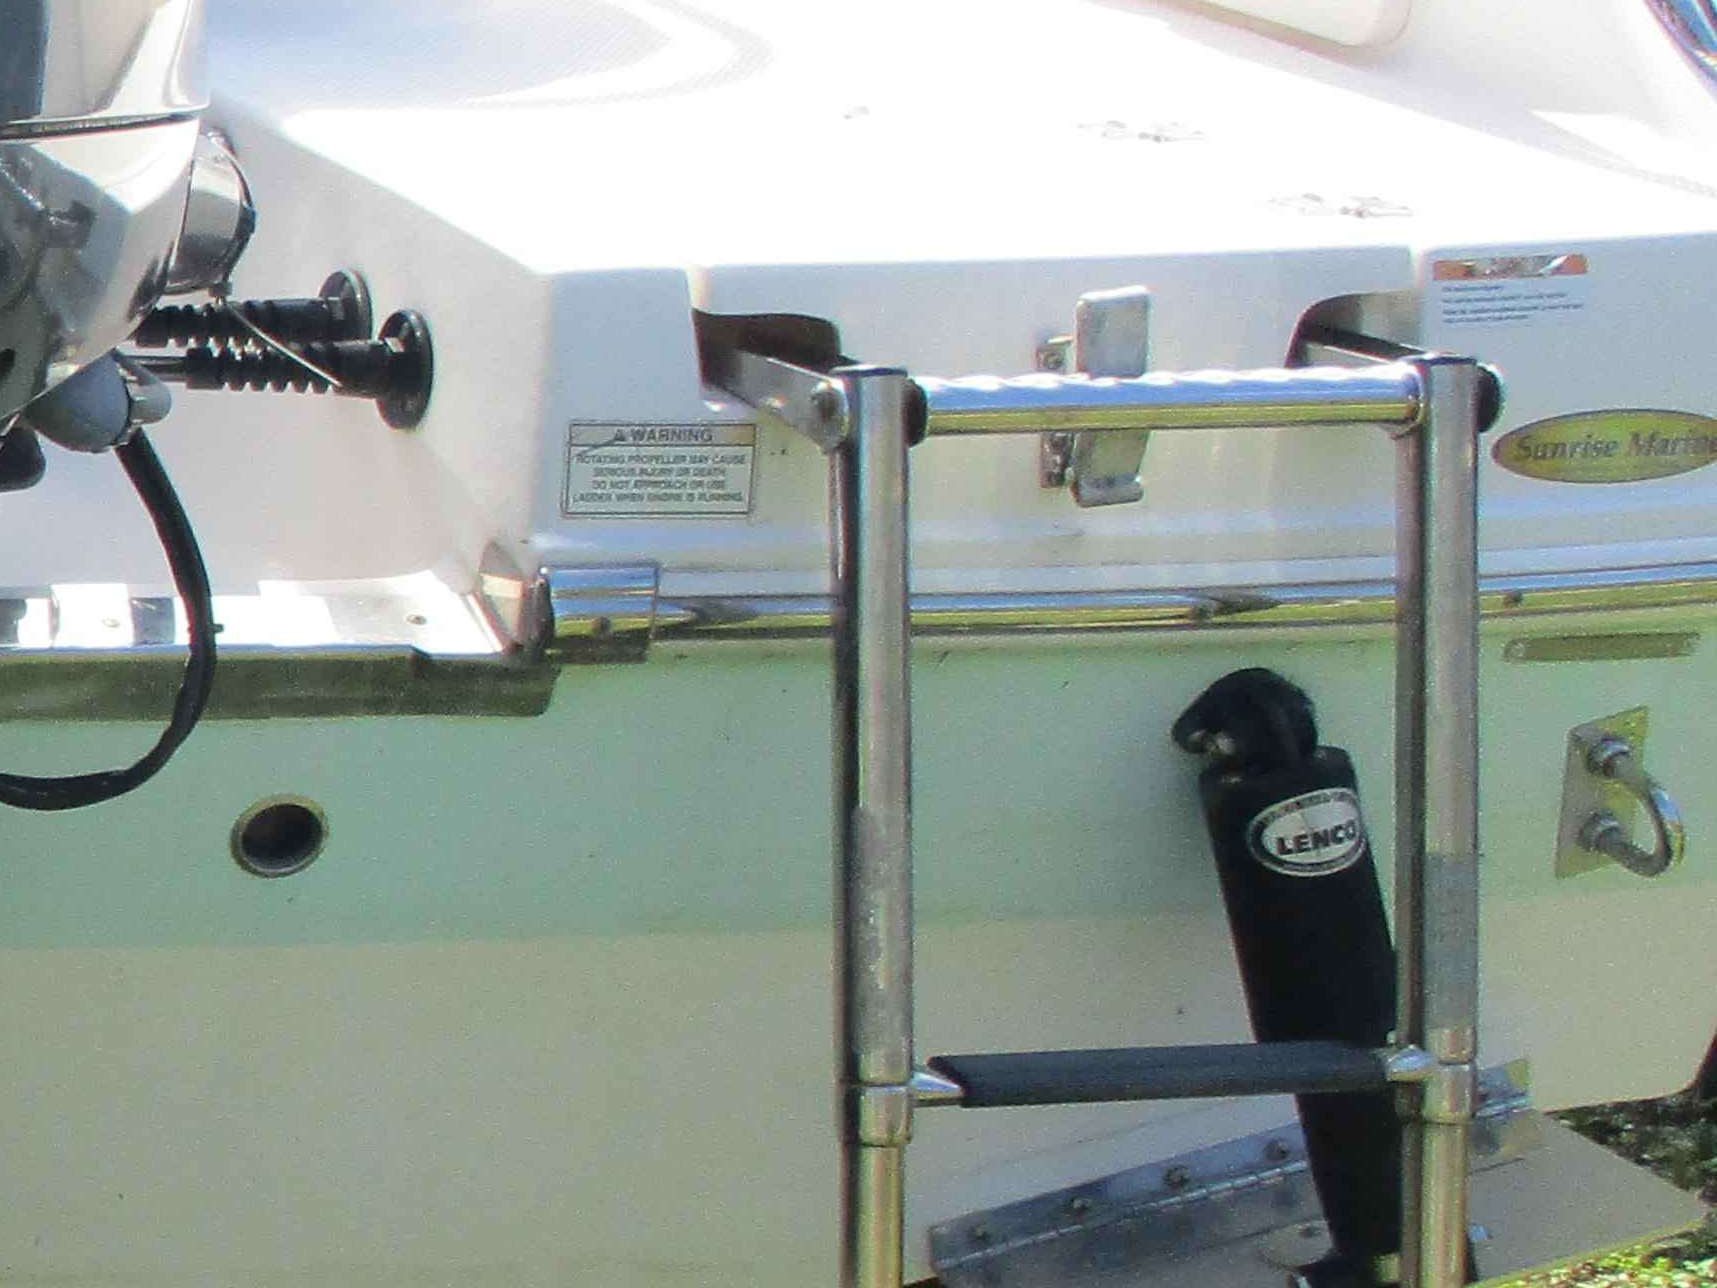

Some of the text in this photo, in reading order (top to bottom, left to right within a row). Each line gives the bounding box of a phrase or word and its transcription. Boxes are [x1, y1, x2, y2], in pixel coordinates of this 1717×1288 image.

[631, 428, 713, 442] WARNING
[1516, 434, 1619, 460] Sunrise
[1275, 818, 1356, 856] LENCO
